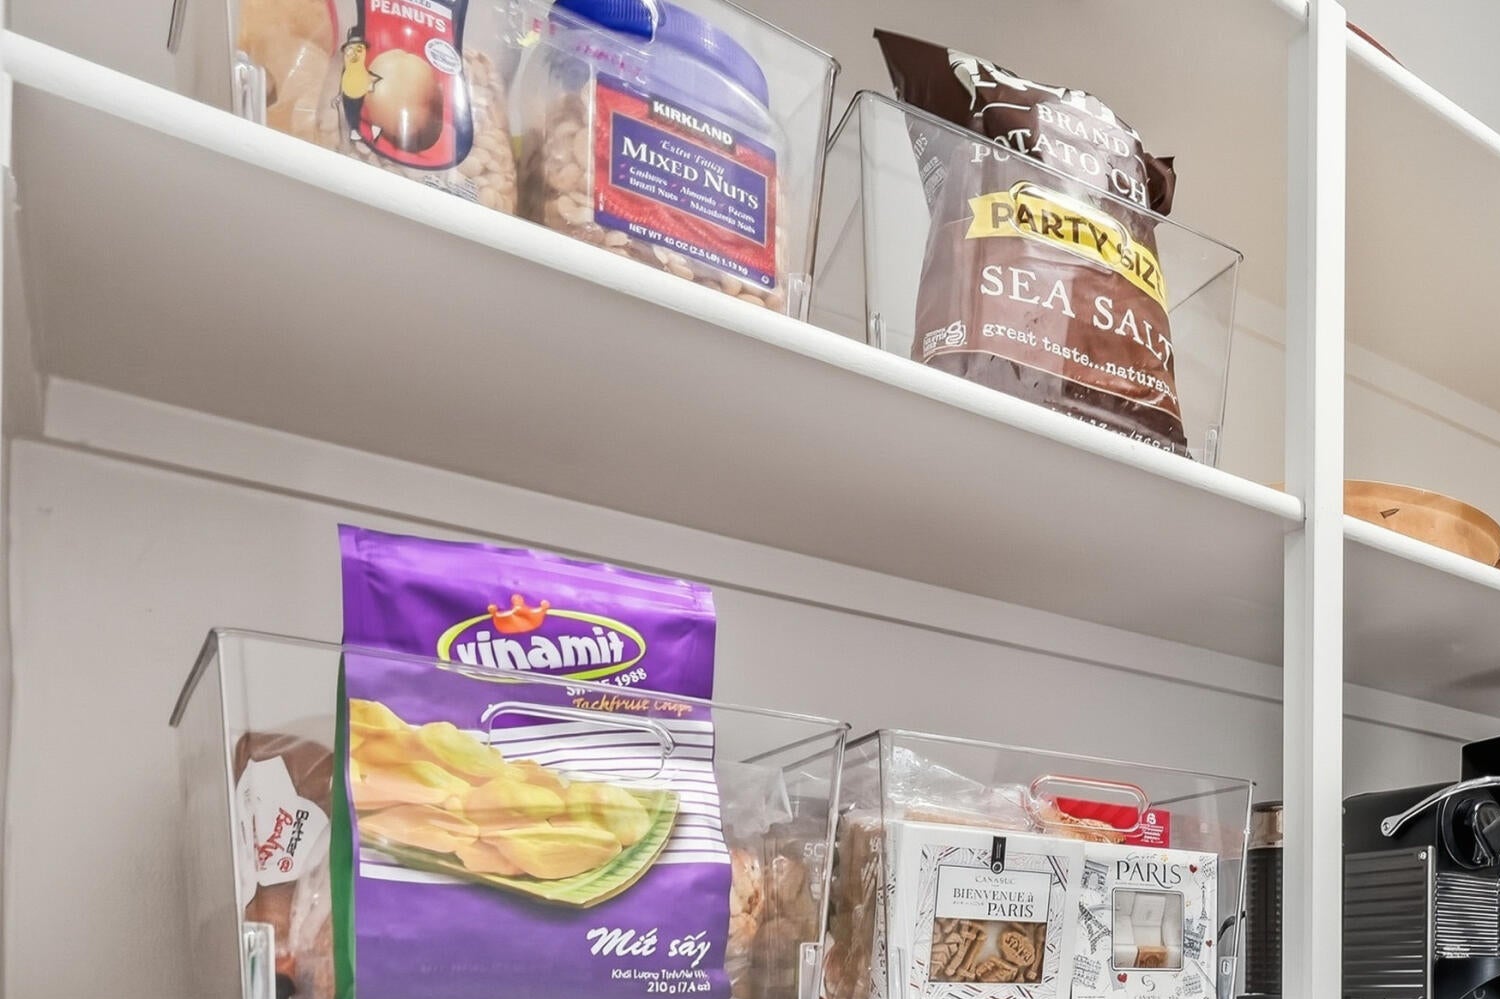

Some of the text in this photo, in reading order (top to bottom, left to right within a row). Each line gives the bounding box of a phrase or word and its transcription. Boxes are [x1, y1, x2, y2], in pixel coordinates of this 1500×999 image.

[370, 0, 447, 33] PEANUTS
[652, 100, 735, 146] KIRKLAND
[1036, 102, 1131, 158] BRAND
[970, 128, 1100, 176] POTATO
[621, 136, 759, 211] MIXED NUTS
[990, 203, 1161, 291] PARTY SIZ
[980, 264, 1176, 372] SEA SALT
[982, 321, 1037, 347] great
[456, 625, 625, 670] vinamit
[614, 667, 648, 688] 1988
[1115, 859, 1183, 890] PARIS
[952, 887, 1025, 903] BIENVENUE
[987, 901, 1035, 919] PARIS
[646, 980, 668, 994] 210
